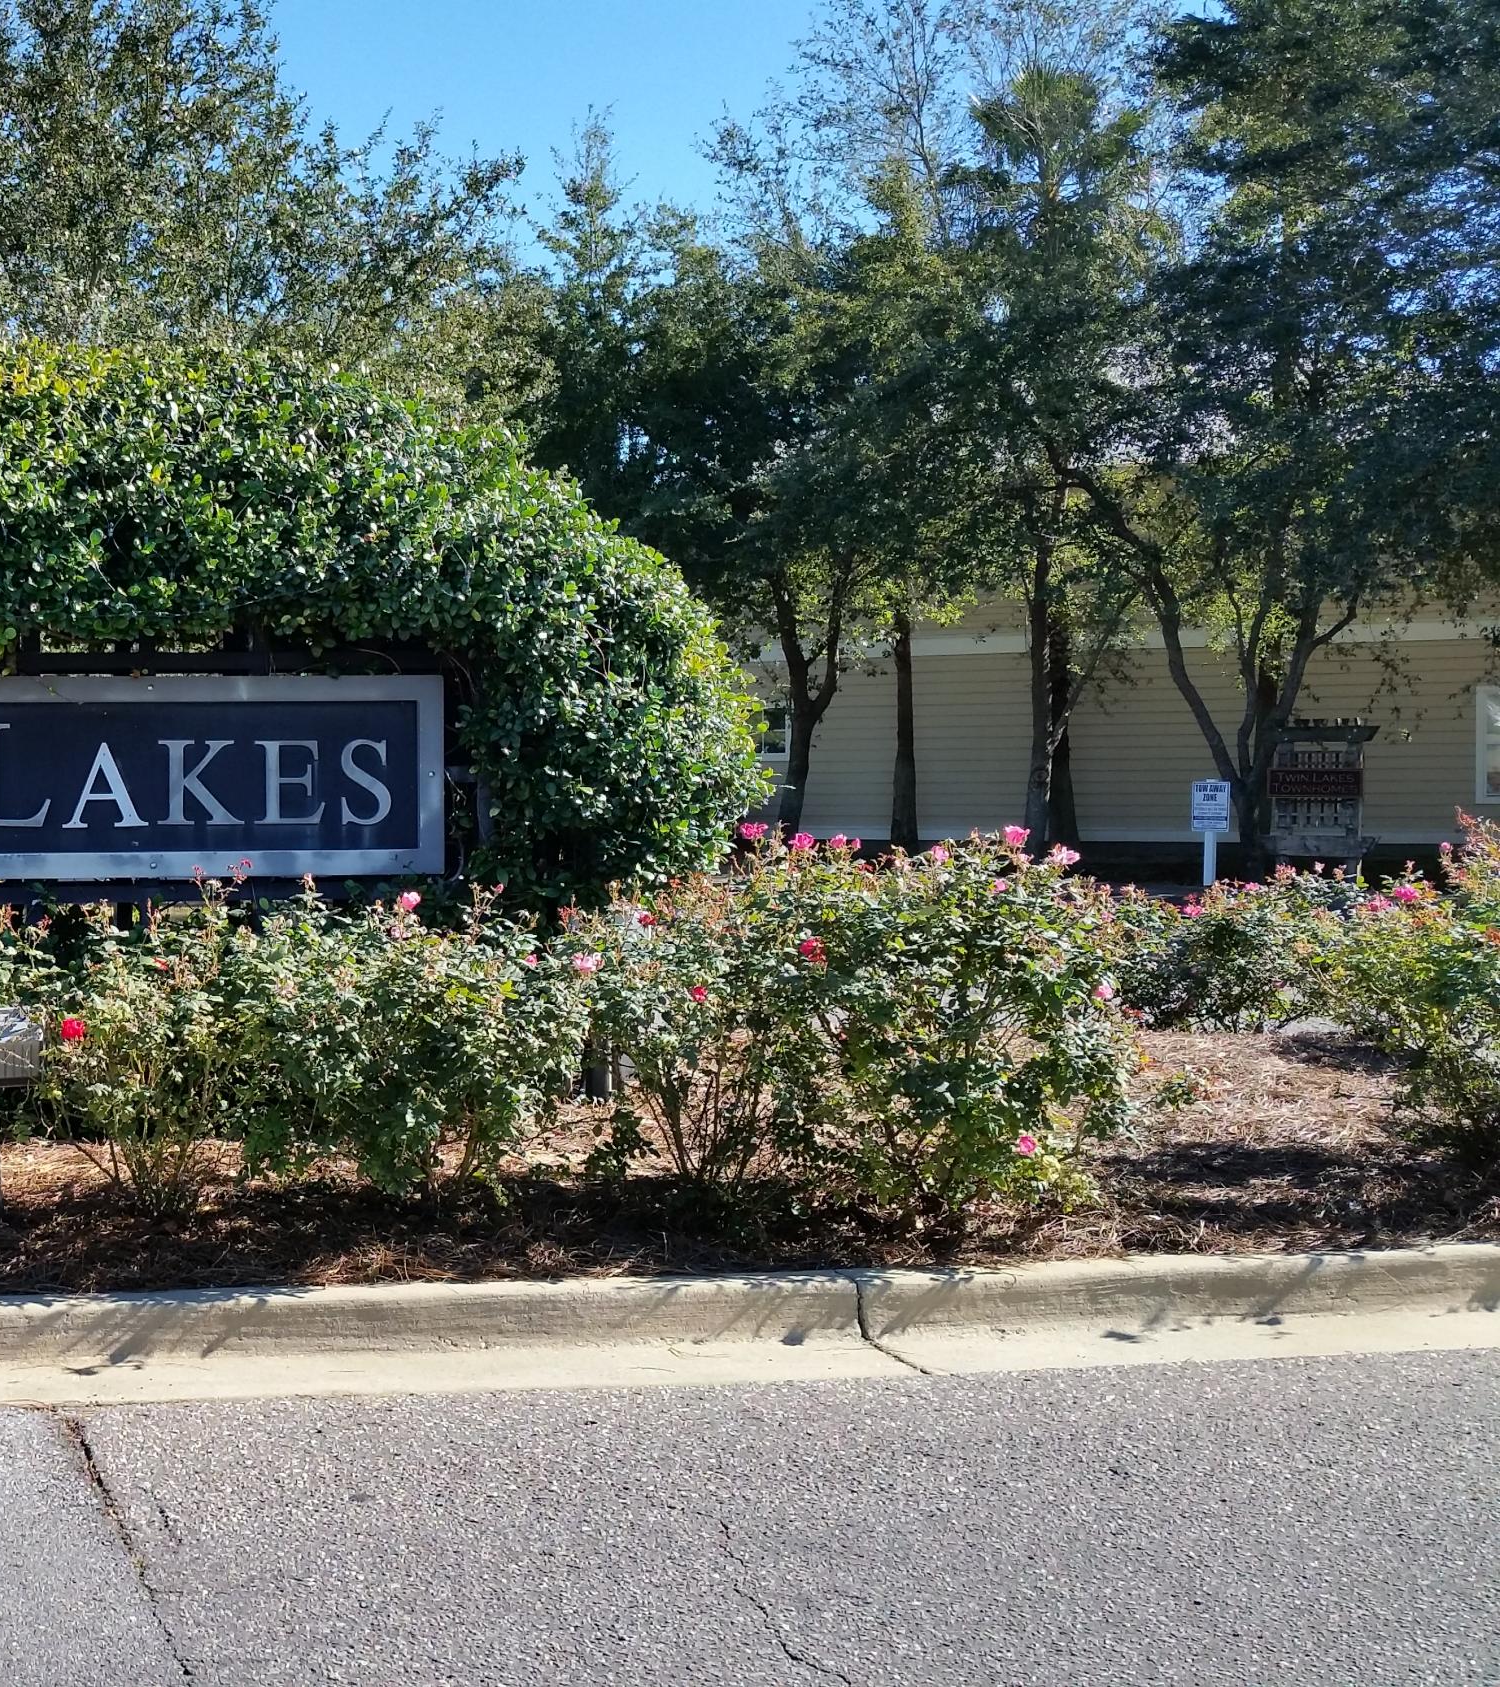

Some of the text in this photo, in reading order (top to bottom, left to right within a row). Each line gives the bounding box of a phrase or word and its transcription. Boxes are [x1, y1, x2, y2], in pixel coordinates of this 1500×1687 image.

[1275, 772, 1355, 783] TWIN LAKES
[1195, 784, 1226, 793] TOW AWAY
[1273, 782, 1358, 794] TOWNHOMES
[1202, 793, 1218, 802] ZONE
